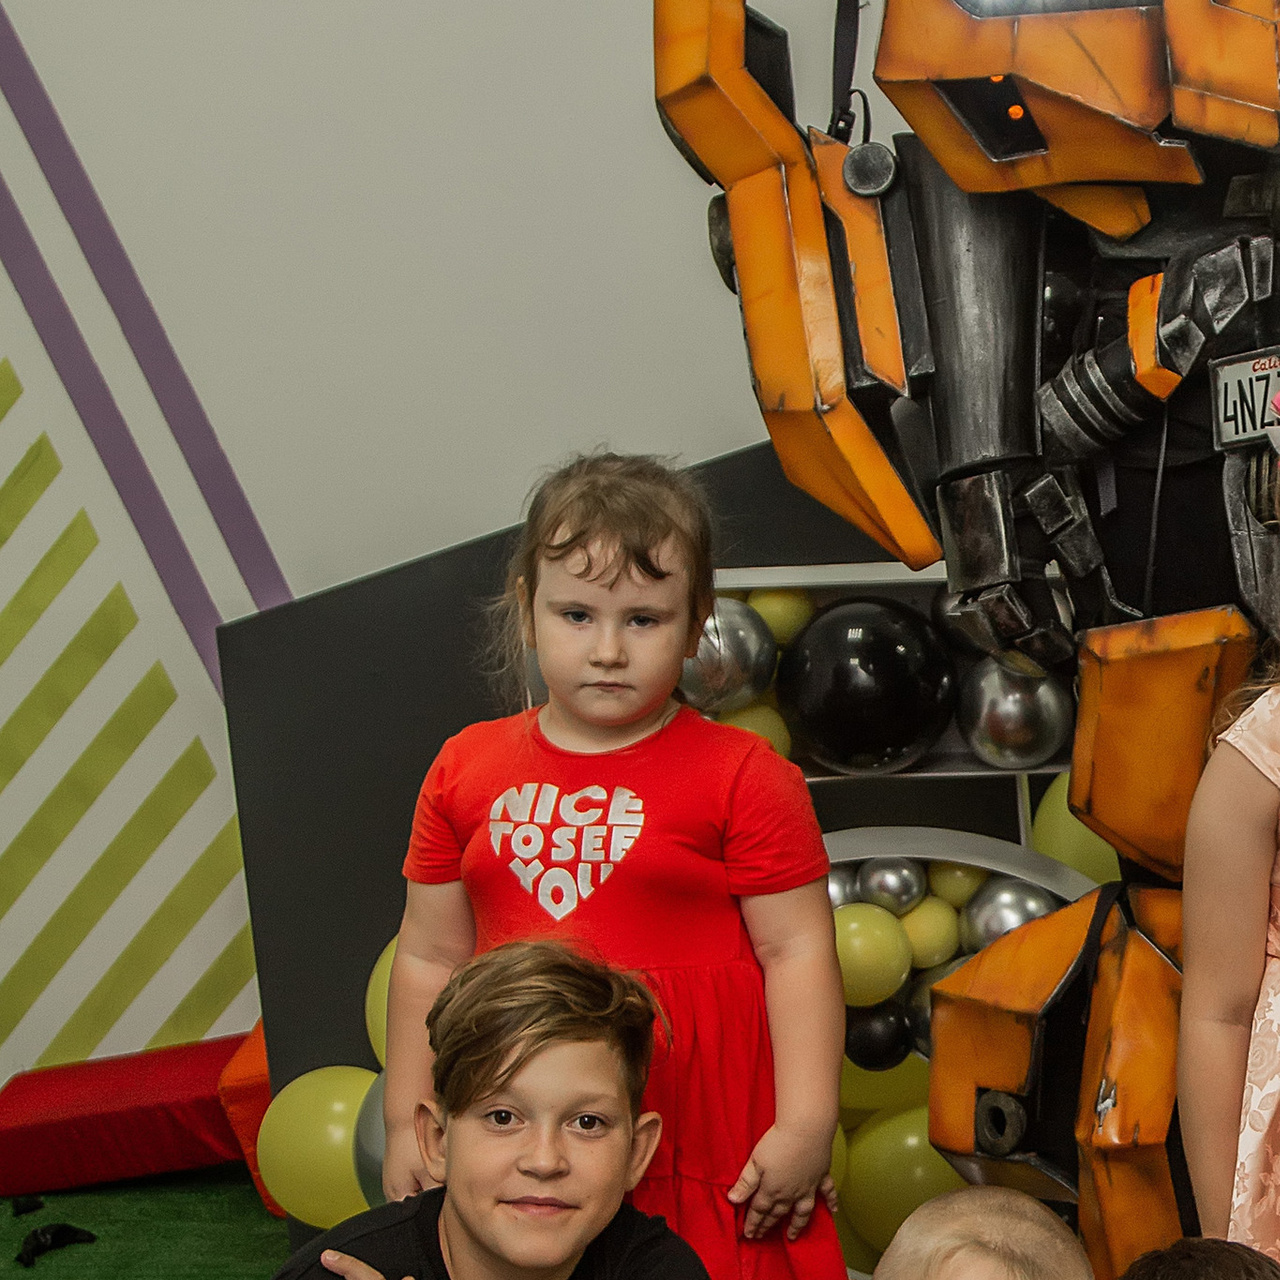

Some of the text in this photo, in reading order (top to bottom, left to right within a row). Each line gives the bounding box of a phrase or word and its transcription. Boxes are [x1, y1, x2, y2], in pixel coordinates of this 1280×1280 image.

[489, 782, 645, 826] NICE
[488, 821, 643, 862] TO SEE
[508, 857, 614, 921] YOU
